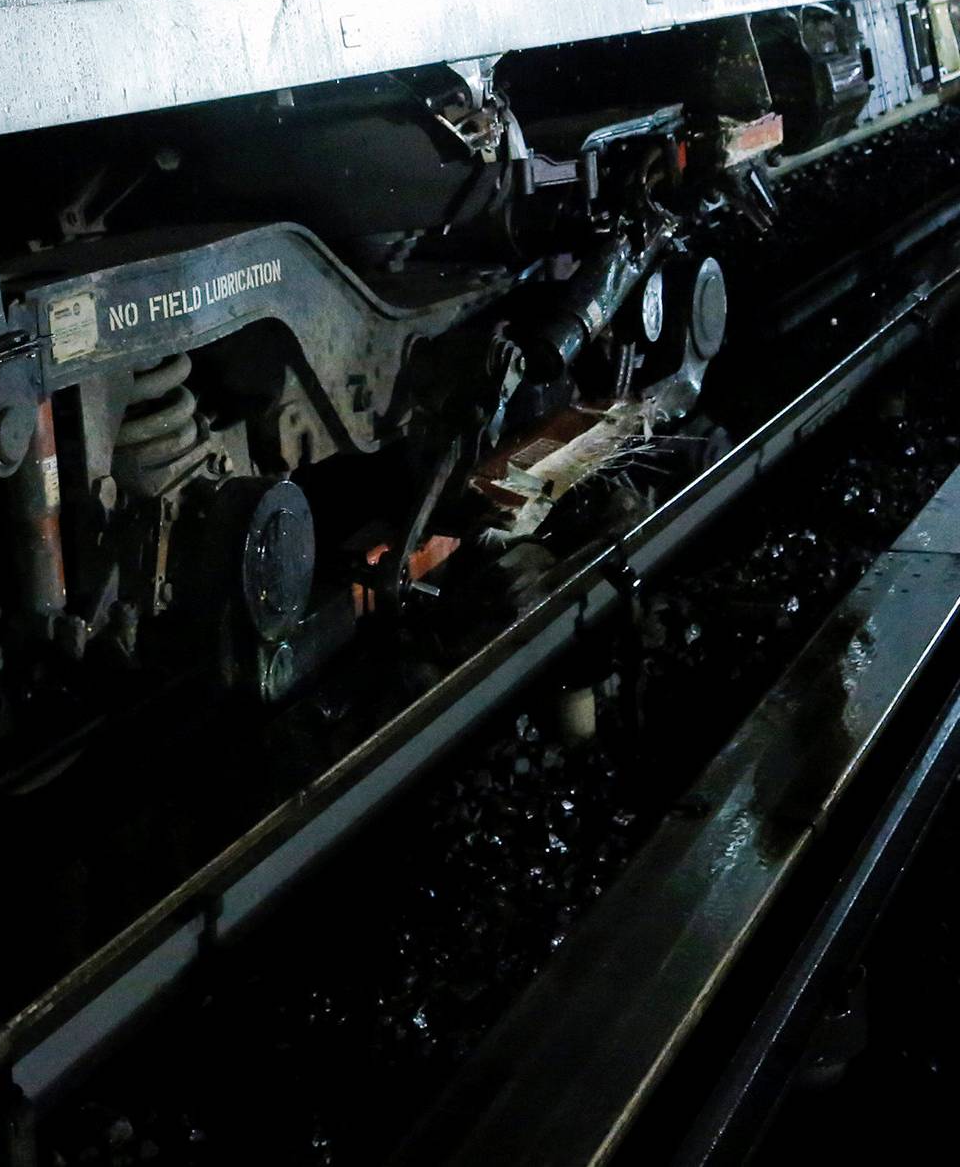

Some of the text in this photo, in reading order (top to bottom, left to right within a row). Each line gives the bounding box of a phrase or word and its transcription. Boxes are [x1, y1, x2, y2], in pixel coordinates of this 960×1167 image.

[108, 302, 138, 331] NO
[149, 285, 202, 322] FIELD
[205, 258, 282, 306] LUBRICATION
